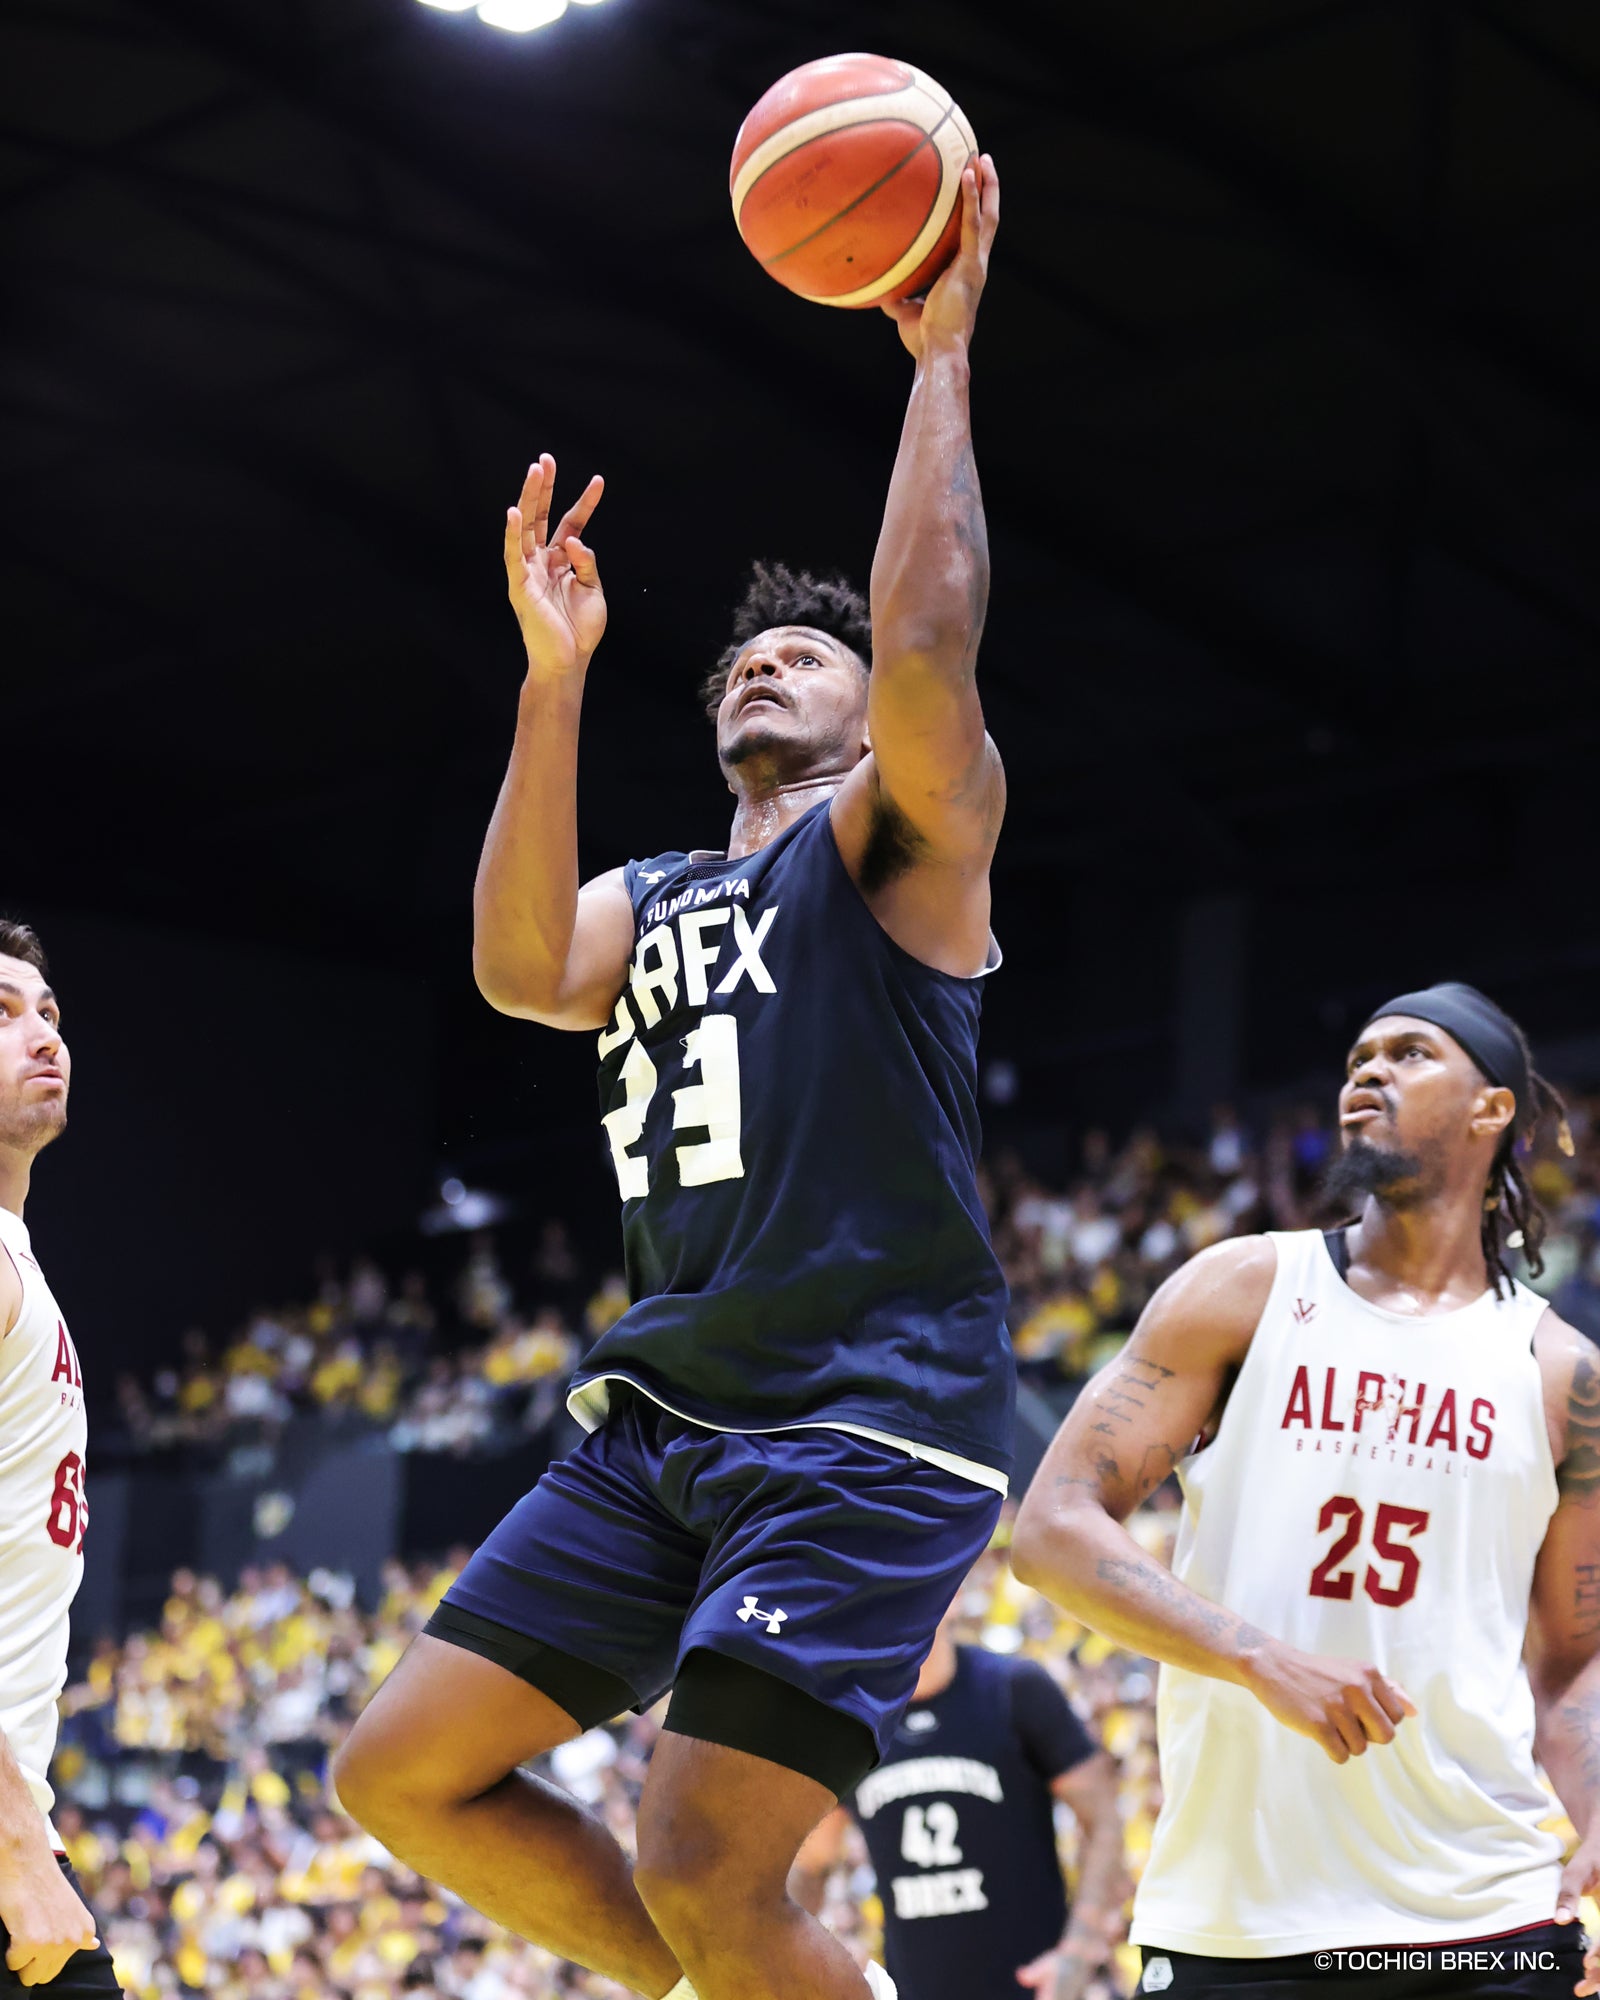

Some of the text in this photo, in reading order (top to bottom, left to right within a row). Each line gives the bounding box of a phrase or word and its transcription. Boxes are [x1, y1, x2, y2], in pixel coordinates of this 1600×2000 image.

[639, 878, 750, 937] SUNOMIYA
[600, 1013, 745, 1202] 23
[1280, 1365, 1497, 1461] ALPHAS
[1296, 1438, 1470, 1478] BASKETBALL
[1308, 1495, 1431, 1608] 25
[901, 1802, 962, 1867] 42
